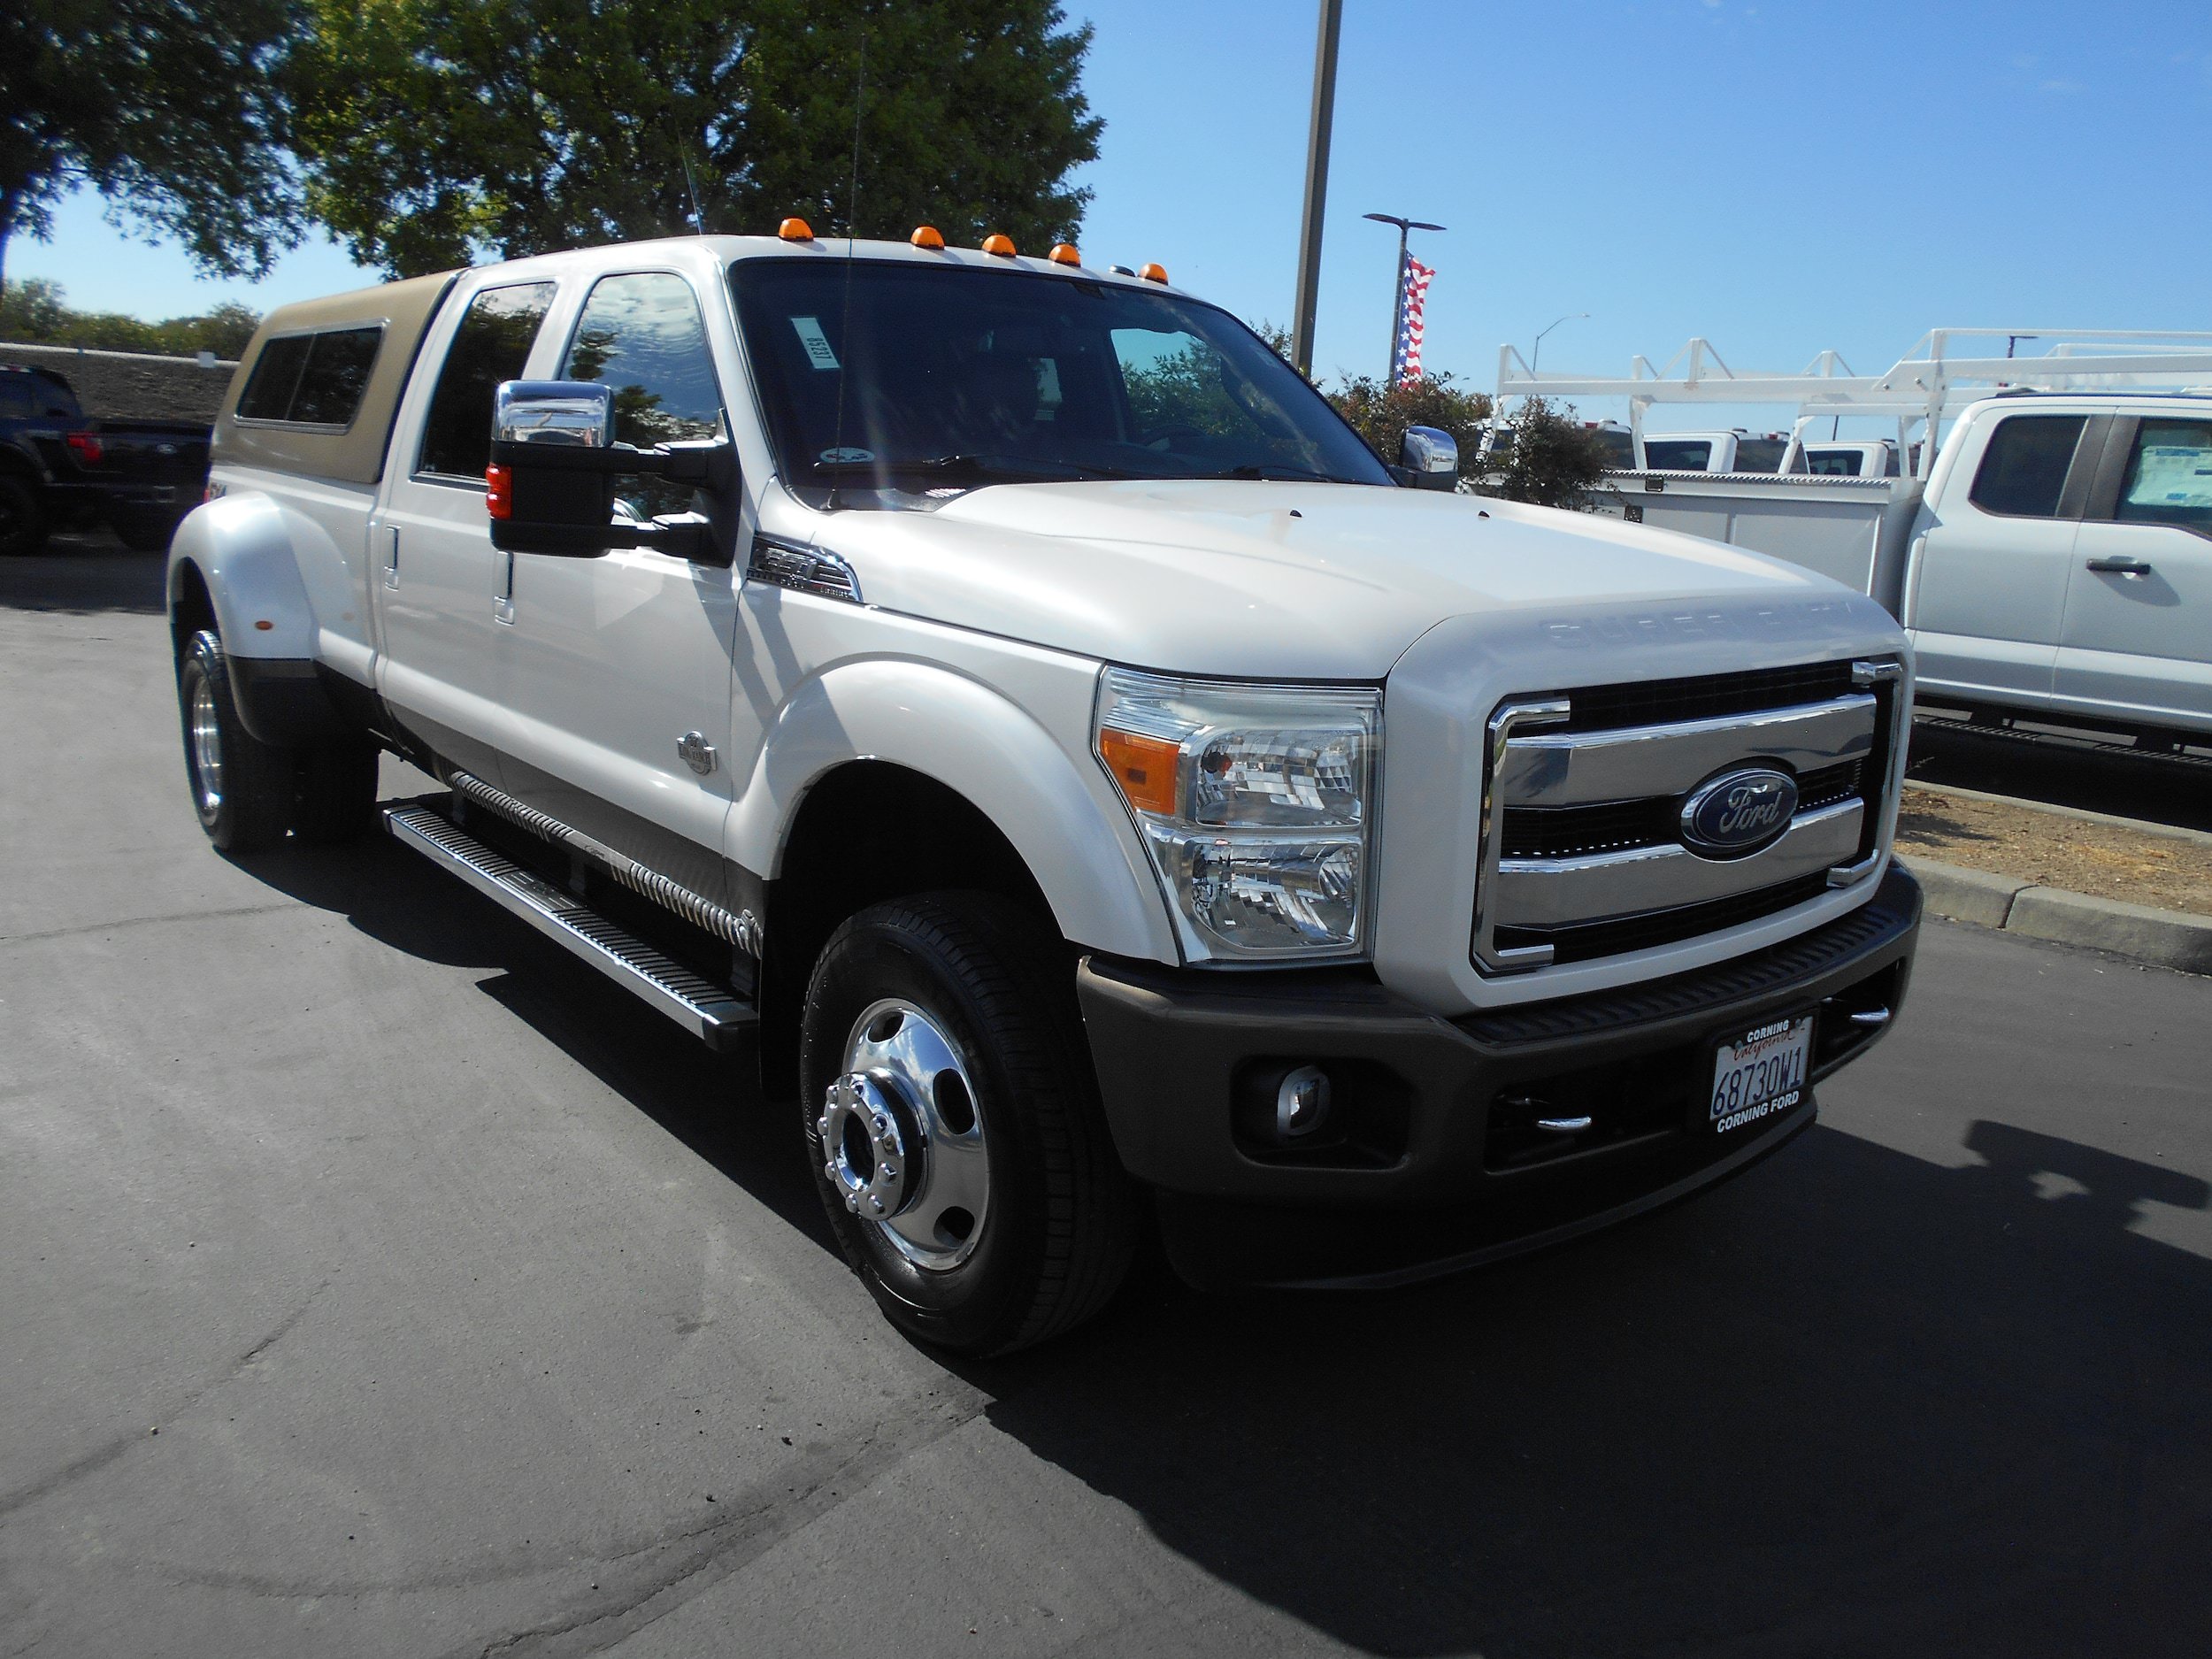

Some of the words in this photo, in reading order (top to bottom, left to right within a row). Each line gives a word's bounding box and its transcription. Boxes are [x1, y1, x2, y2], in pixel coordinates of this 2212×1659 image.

[806, 337, 833, 359] 85237
[1719, 784, 1783, 833] Ford
[1747, 1018, 1790, 1043] CORNING
[1712, 1046, 1801, 1115] 68730W1
[1717, 1102, 1769, 1133] CORNING
[1770, 1090, 1800, 1113] FORD
